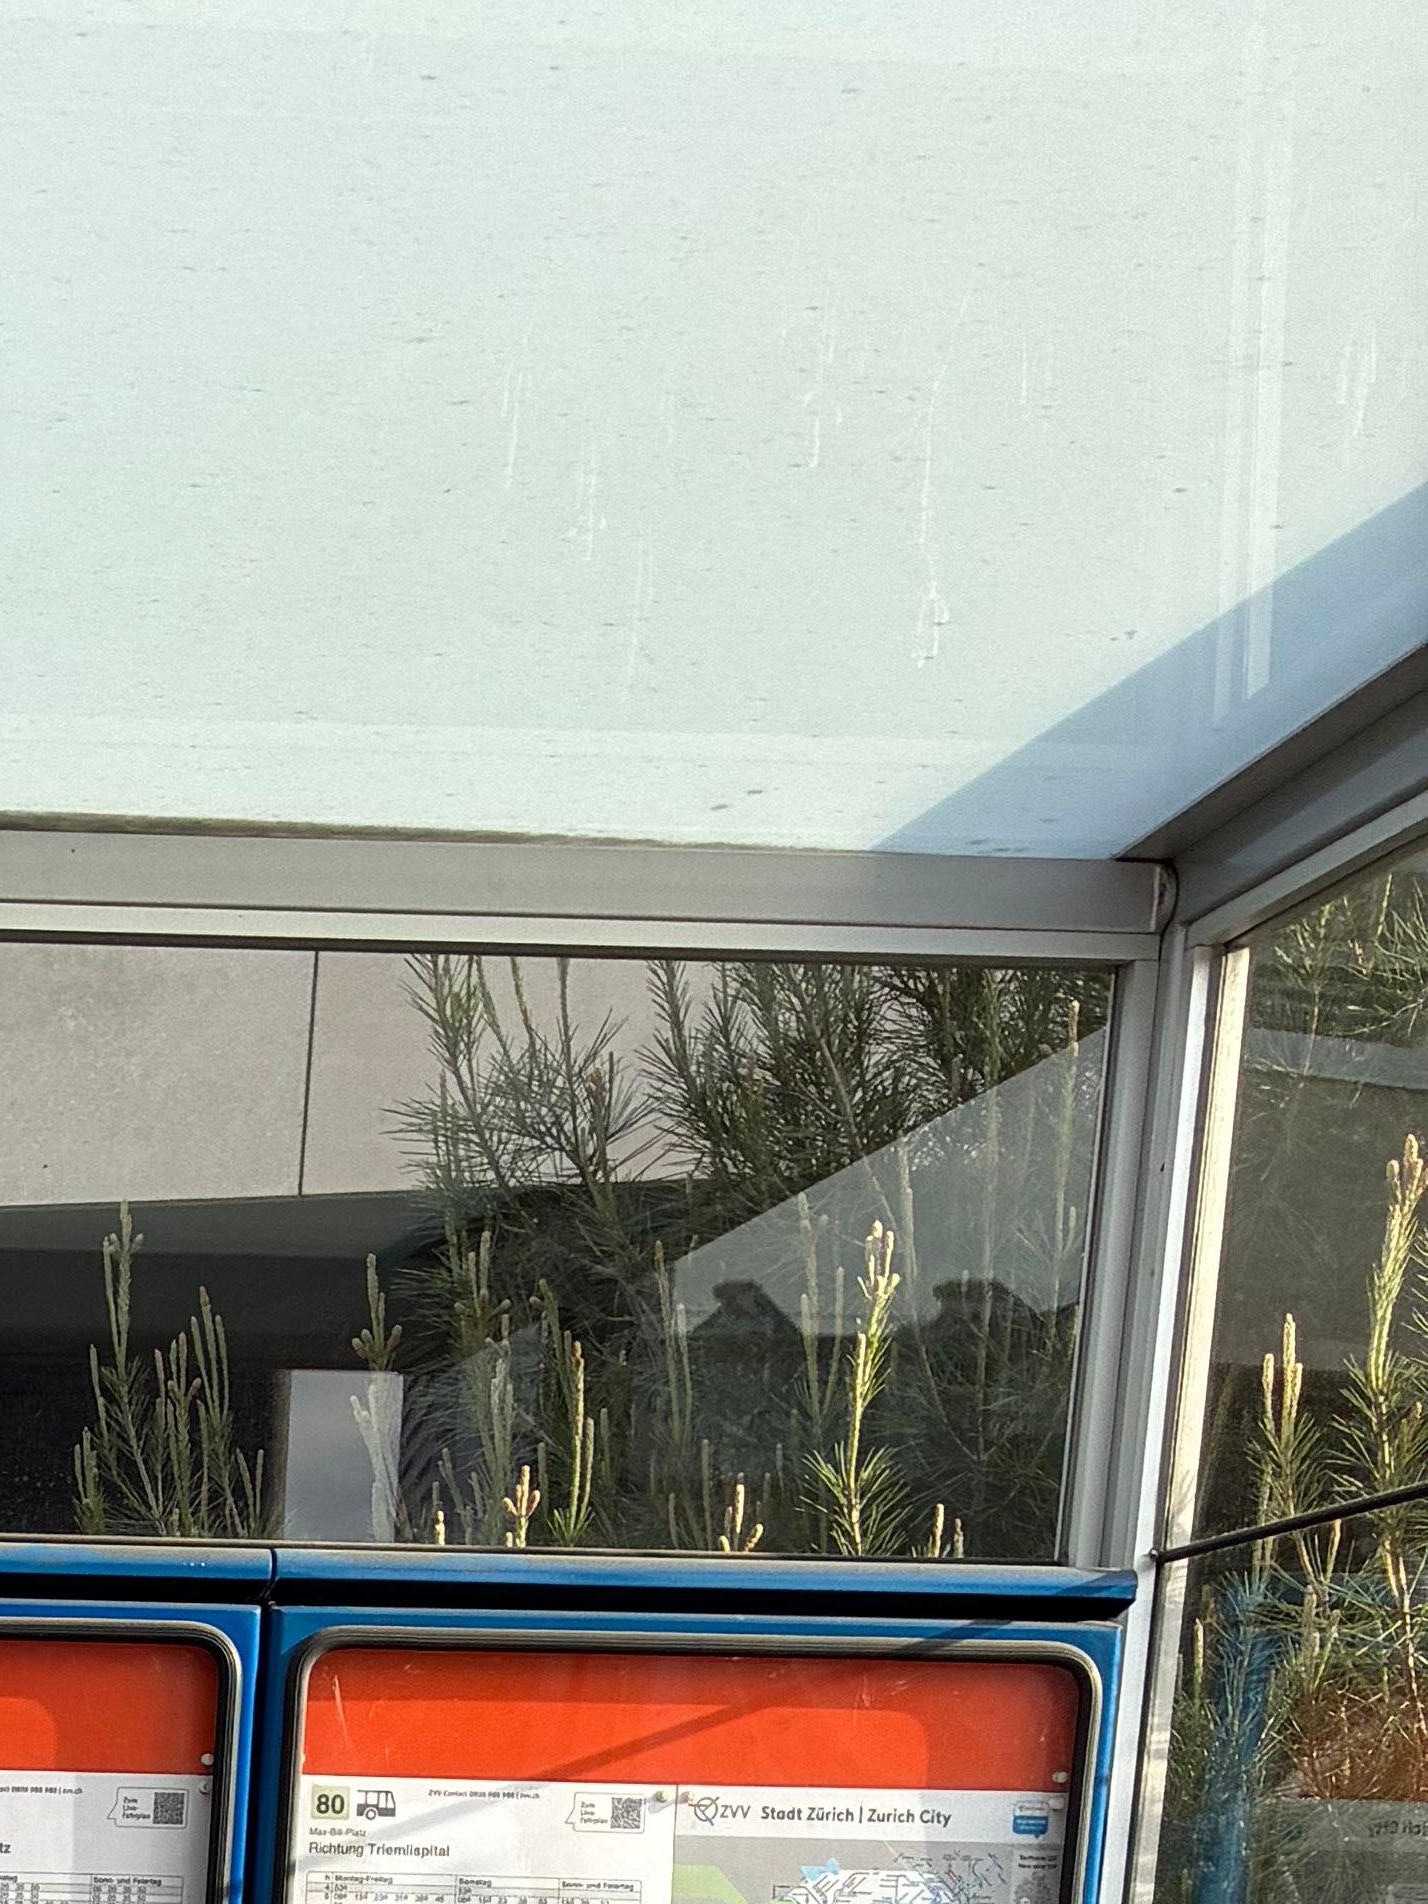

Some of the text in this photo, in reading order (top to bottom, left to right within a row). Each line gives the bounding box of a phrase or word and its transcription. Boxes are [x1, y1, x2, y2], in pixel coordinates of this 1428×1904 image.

[316, 1793, 345, 1815] 80
[720, 1805, 952, 1828] ZVV Stadt Zürich Zurich City
[309, 1841, 450, 1858] Richtung Triemlispital
